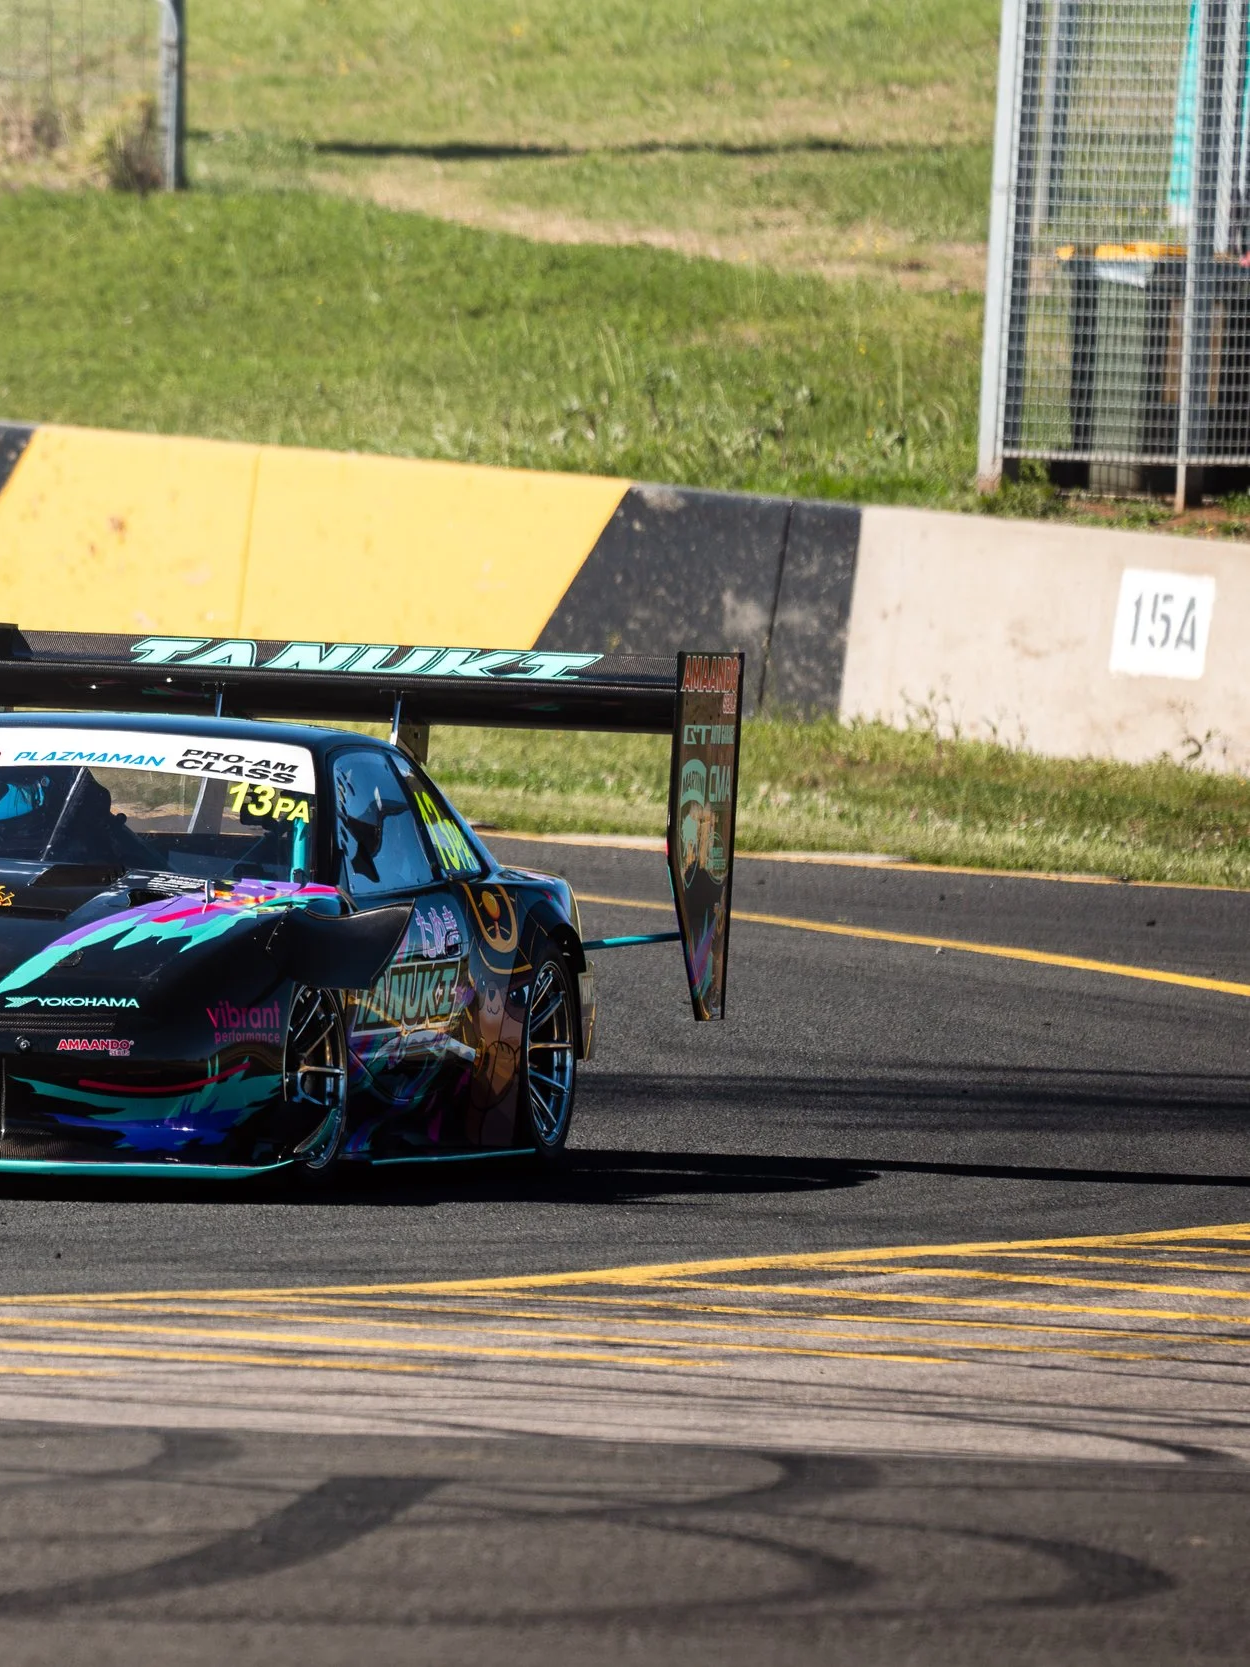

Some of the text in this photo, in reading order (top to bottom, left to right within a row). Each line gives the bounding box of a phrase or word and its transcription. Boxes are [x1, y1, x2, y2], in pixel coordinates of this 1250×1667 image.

[1130, 592, 1196, 652] 15A
[130, 637, 604, 680] TANUKI
[680, 655, 739, 693] AMAANDO
[683, 725, 711, 745] GT
[13, 751, 166, 767] PLAZMAMAN
[176, 758, 297, 784] CLASS
[182, 749, 299, 774] PRO-AM
[708, 765, 731, 803] CMA
[37, 997, 140, 1009] YOKOHAMA
[206, 1000, 281, 1029] vibrant
[56, 1039, 130, 1051] AMAANDO
[214, 1030, 281, 1044] performance
